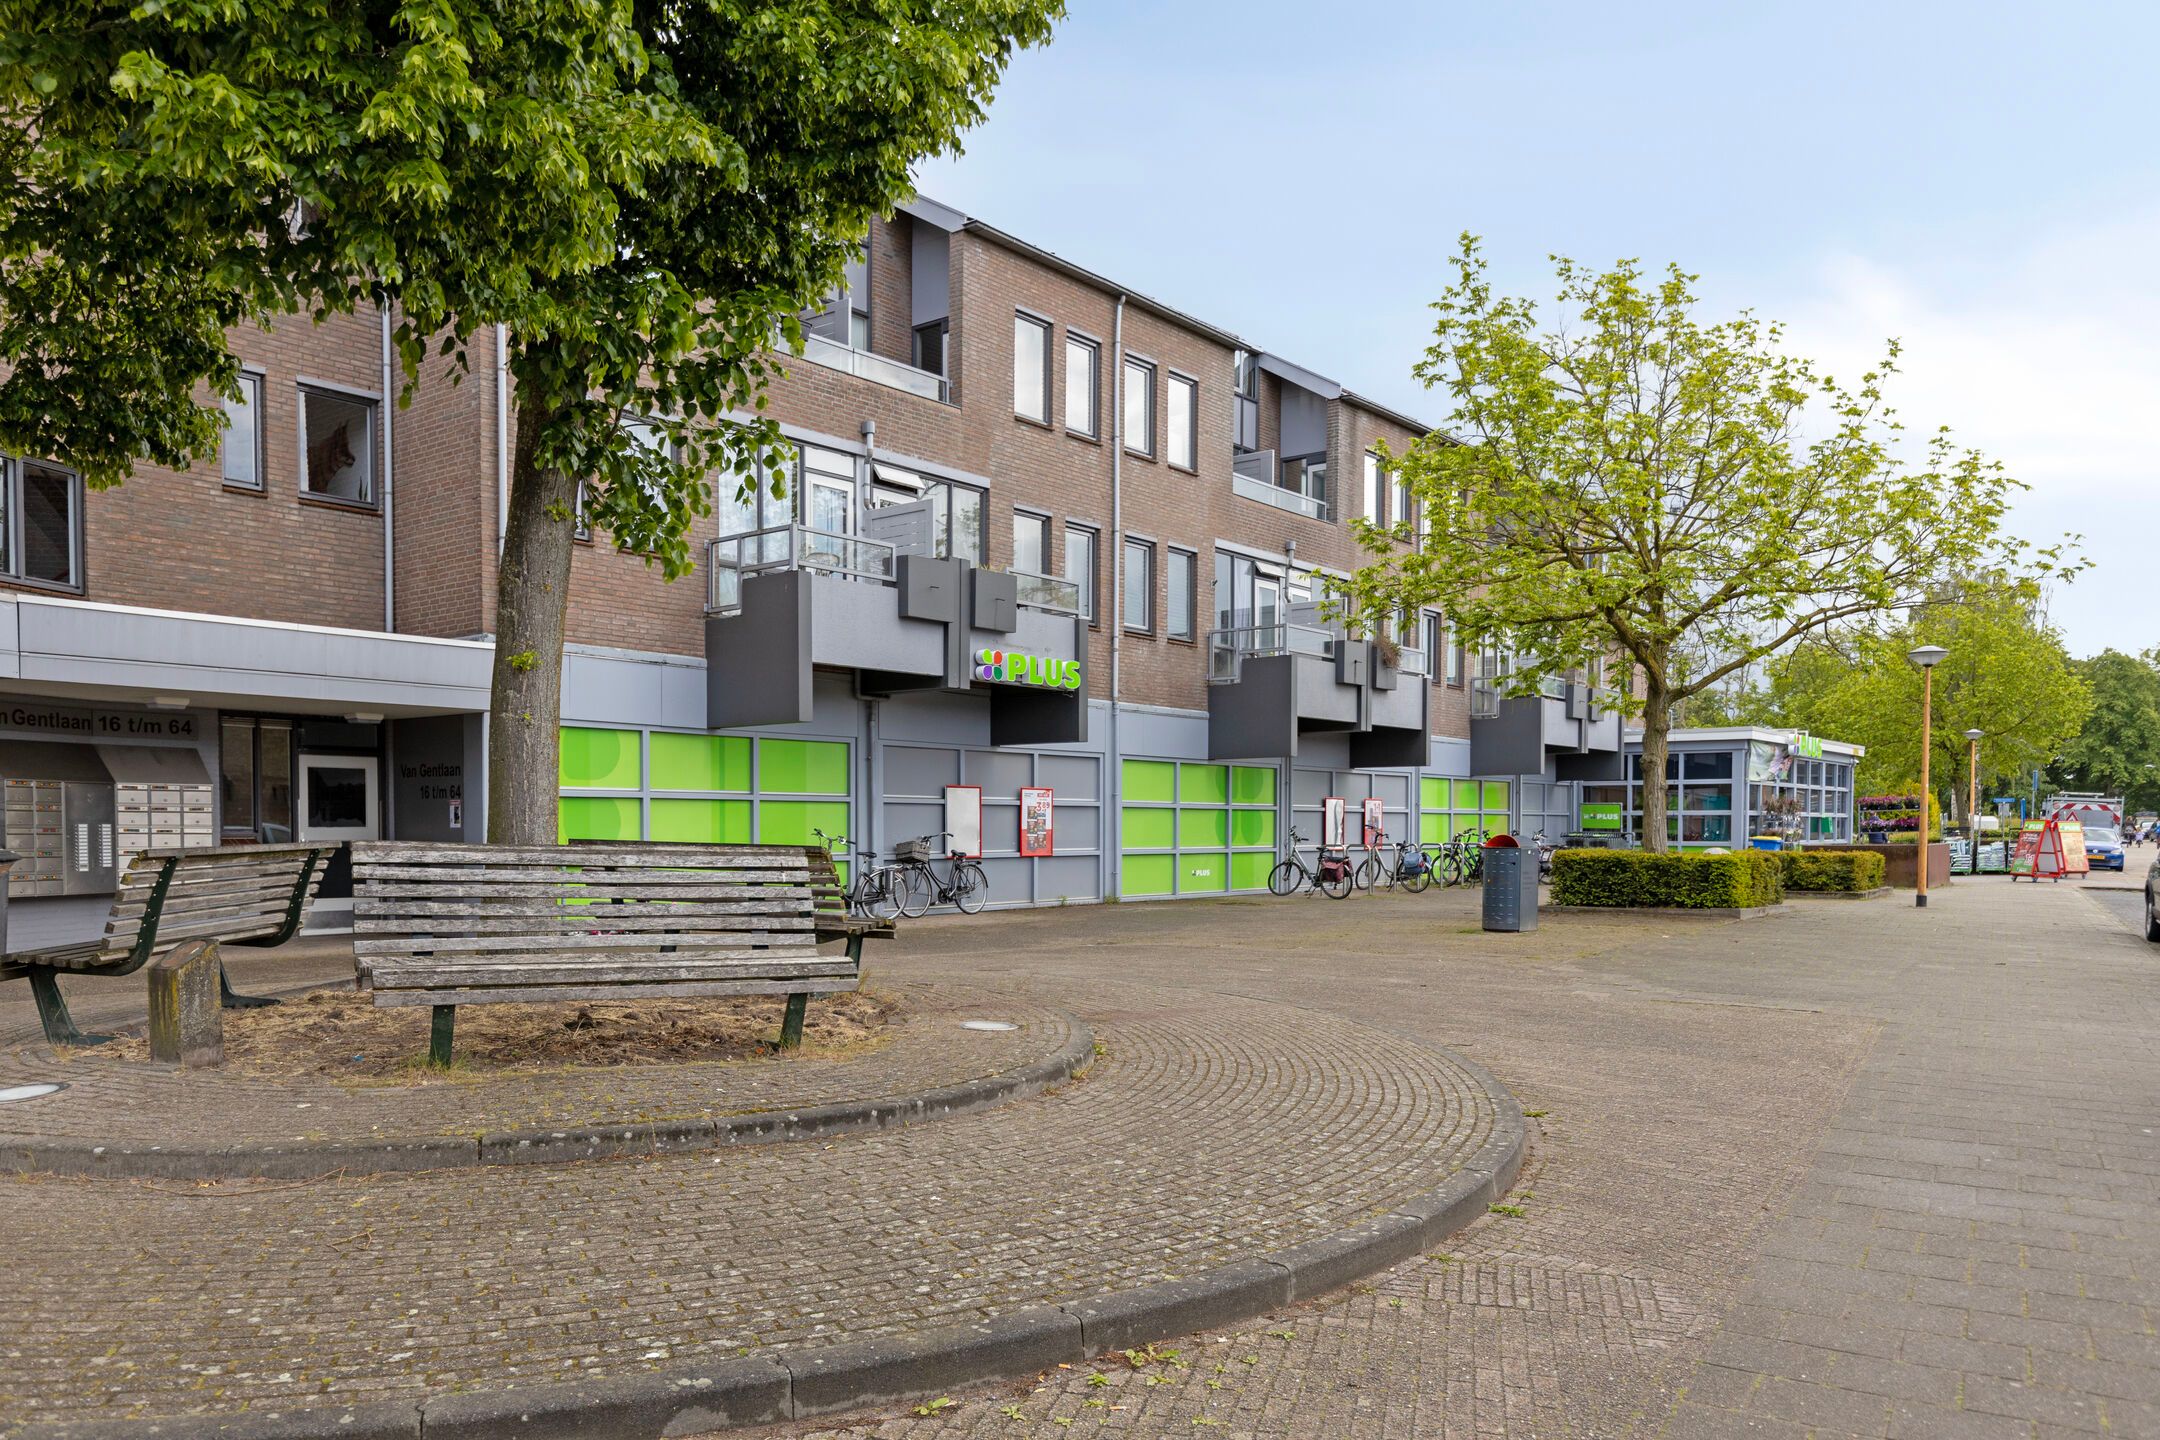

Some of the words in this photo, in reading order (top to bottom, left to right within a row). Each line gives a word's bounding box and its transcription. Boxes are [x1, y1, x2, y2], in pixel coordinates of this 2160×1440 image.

[1007, 652, 1081, 689] PLUS
[12, 709, 91, 730] Gentlaan
[98, 716, 121, 732] 16
[128, 718, 162, 734] t/m
[169, 719, 192, 735] 64
[1801, 735, 1822, 759] PLUS
[401, 764, 417, 778] Van
[420, 763, 461, 777] Gentlaan
[420, 785, 430, 799] 16
[432, 785, 447, 799] t/m
[449, 784, 461, 799] 64
